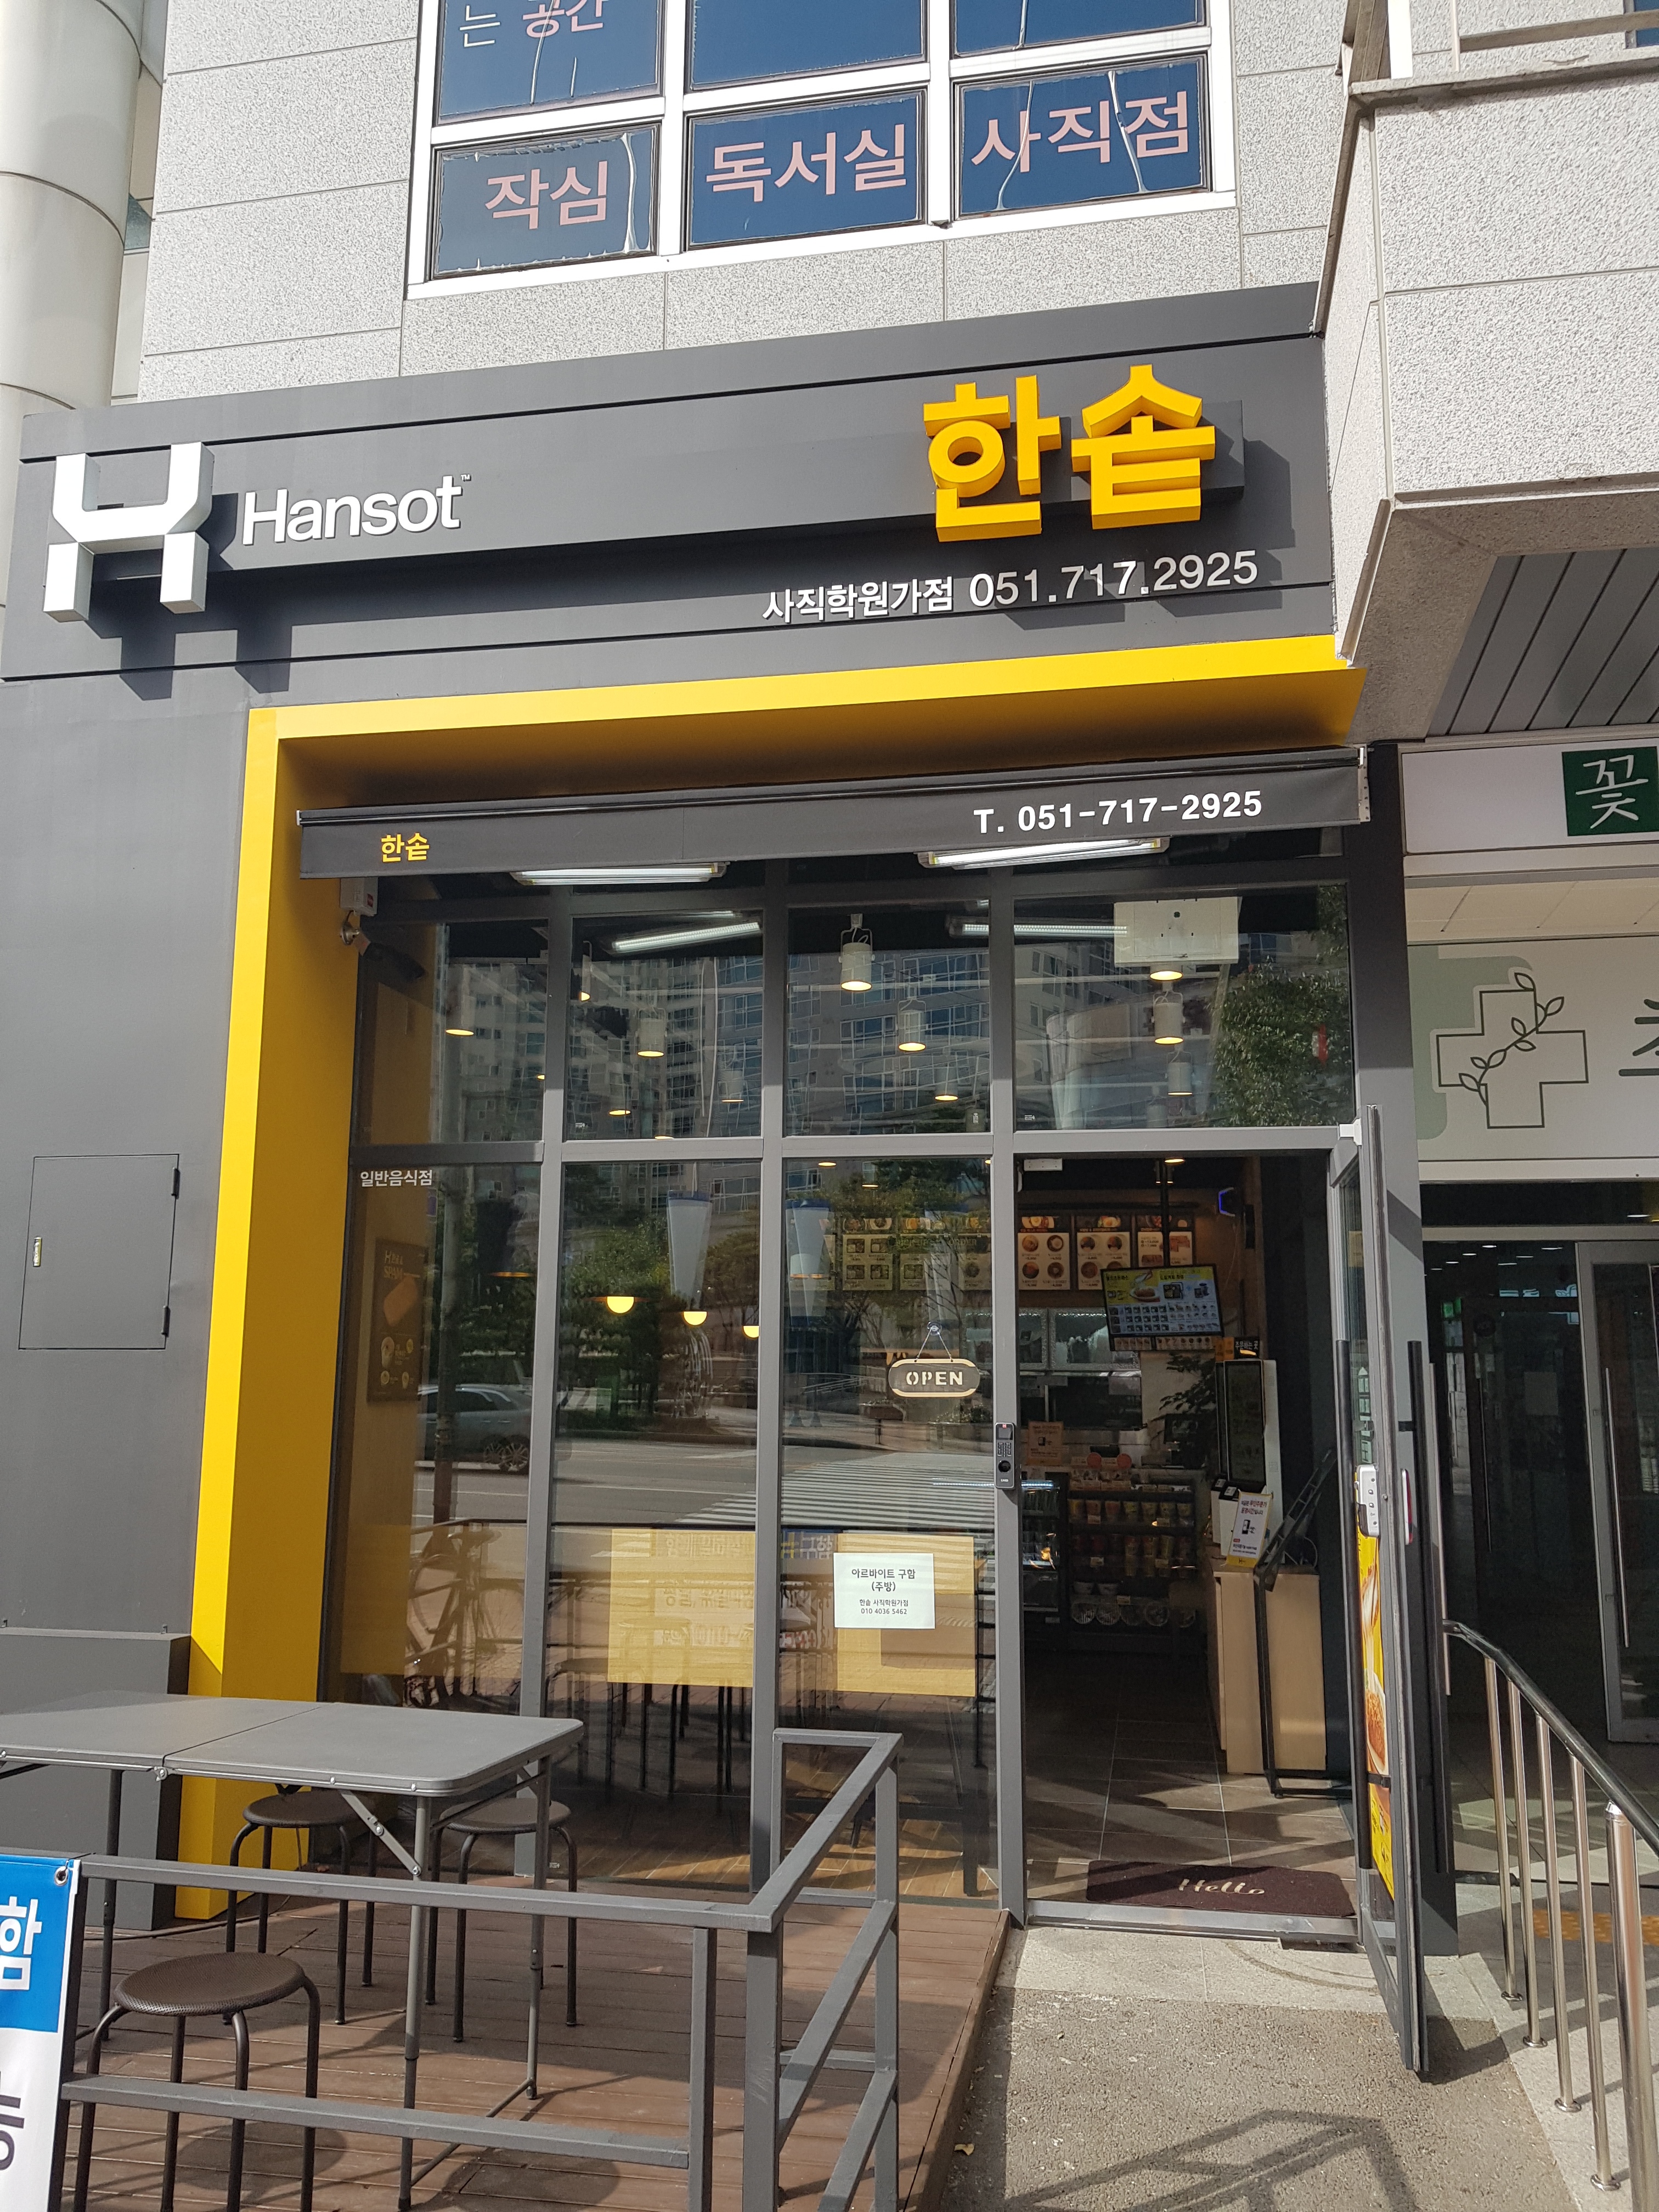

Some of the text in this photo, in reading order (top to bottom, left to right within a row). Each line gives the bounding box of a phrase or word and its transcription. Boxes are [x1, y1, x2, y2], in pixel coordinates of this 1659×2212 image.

[459, 5, 500, 47] 는
[485, 90, 1188, 230] 작심 독서실 사직점
[923, 363, 1216, 542] 한솥
[242, 475, 462, 546] Hansot
[761, 549, 1259, 624] 사직학원가점 051.717.2925
[1576, 754, 1649, 830] 꽃
[973, 790, 1262, 833] T. 051-717-2925
[381, 832, 430, 862] 한솥
[360, 1169, 432, 1187] 일반음식점
[906, 1371, 963, 1385] OPEN
[851, 1568, 916, 1579] 아르바이트 구함
[871, 1581, 896, 1592] (주방)
[873, 1599, 909, 1607] 사직학원가점
[1178, 1878, 1265, 1895] Hello
